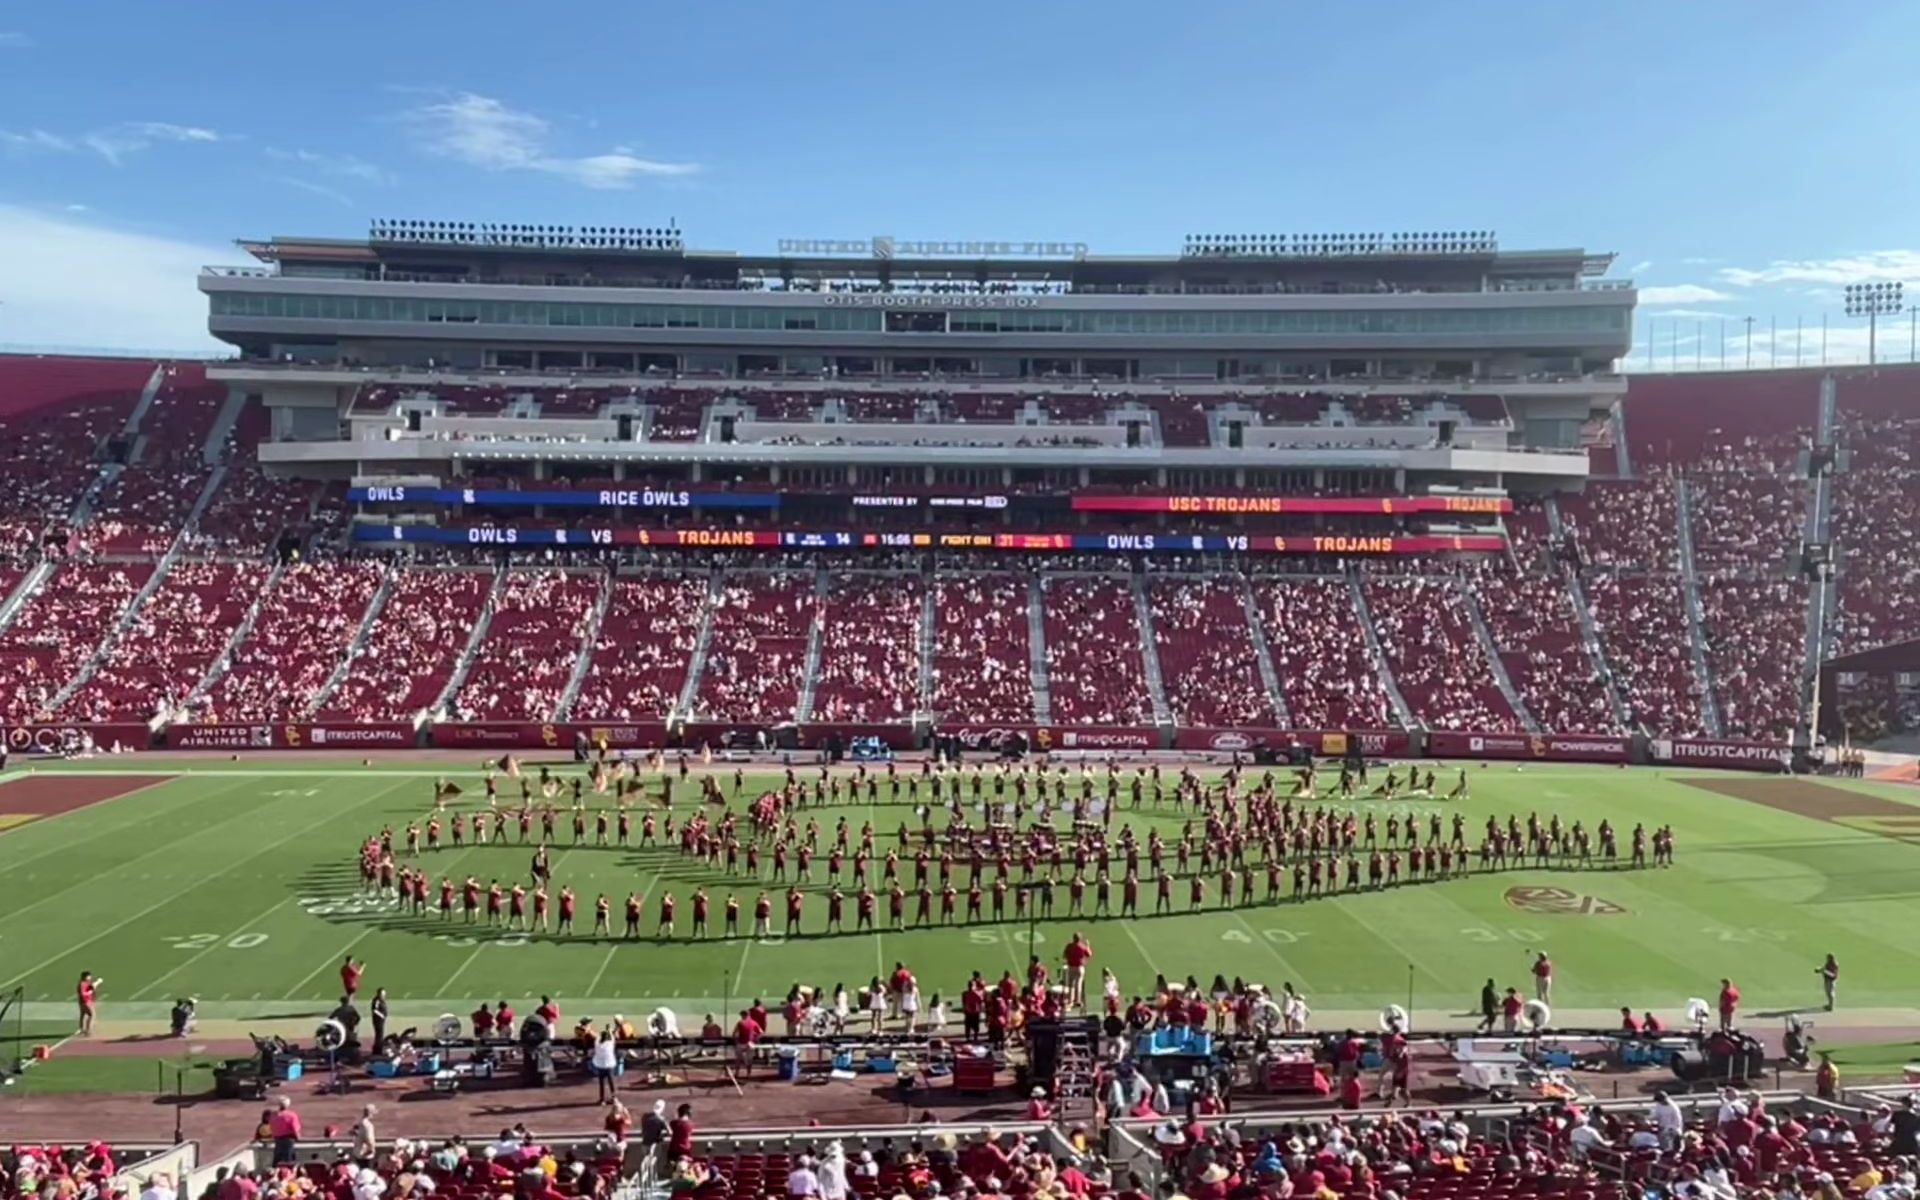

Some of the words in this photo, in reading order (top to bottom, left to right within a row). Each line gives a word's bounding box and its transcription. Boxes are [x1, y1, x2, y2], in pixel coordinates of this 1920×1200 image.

[777, 239, 865, 253] UNITED
[892, 240, 1008, 255] AIRLINES
[1022, 242, 1087, 257] FIELD
[825, 295, 863, 305] OTIS
[872, 296, 932, 306] BOOTH
[941, 297, 995, 307] PRESS
[1006, 297, 1038, 308] BOX
[367, 487, 405, 501] OWLS
[599, 491, 638, 505] RICE
[642, 491, 690, 506] OWLS
[853, 497, 904, 506] PRESENTED
[906, 497, 918, 506] BY
[1168, 497, 1200, 511] USC
[1204, 498, 1280, 512] TROJANS
[1445, 498, 1500, 511] TROJANS
[469, 529, 517, 543] OWLS
[591, 530, 612, 543] VS
[677, 531, 755, 545] TROJANS
[835, 533, 850, 545] 14
[999, 534, 1013, 547] 31
[1107, 535, 1155, 549] OWLS
[1226, 536, 1249, 550] VS
[1313, 537, 1393, 551] TROJANS
[193, 728, 247, 736] UNITED
[180, 737, 247, 746] AIRLINES
[969, 930, 1046, 944] 50
[1221, 929, 1298, 943] 40
